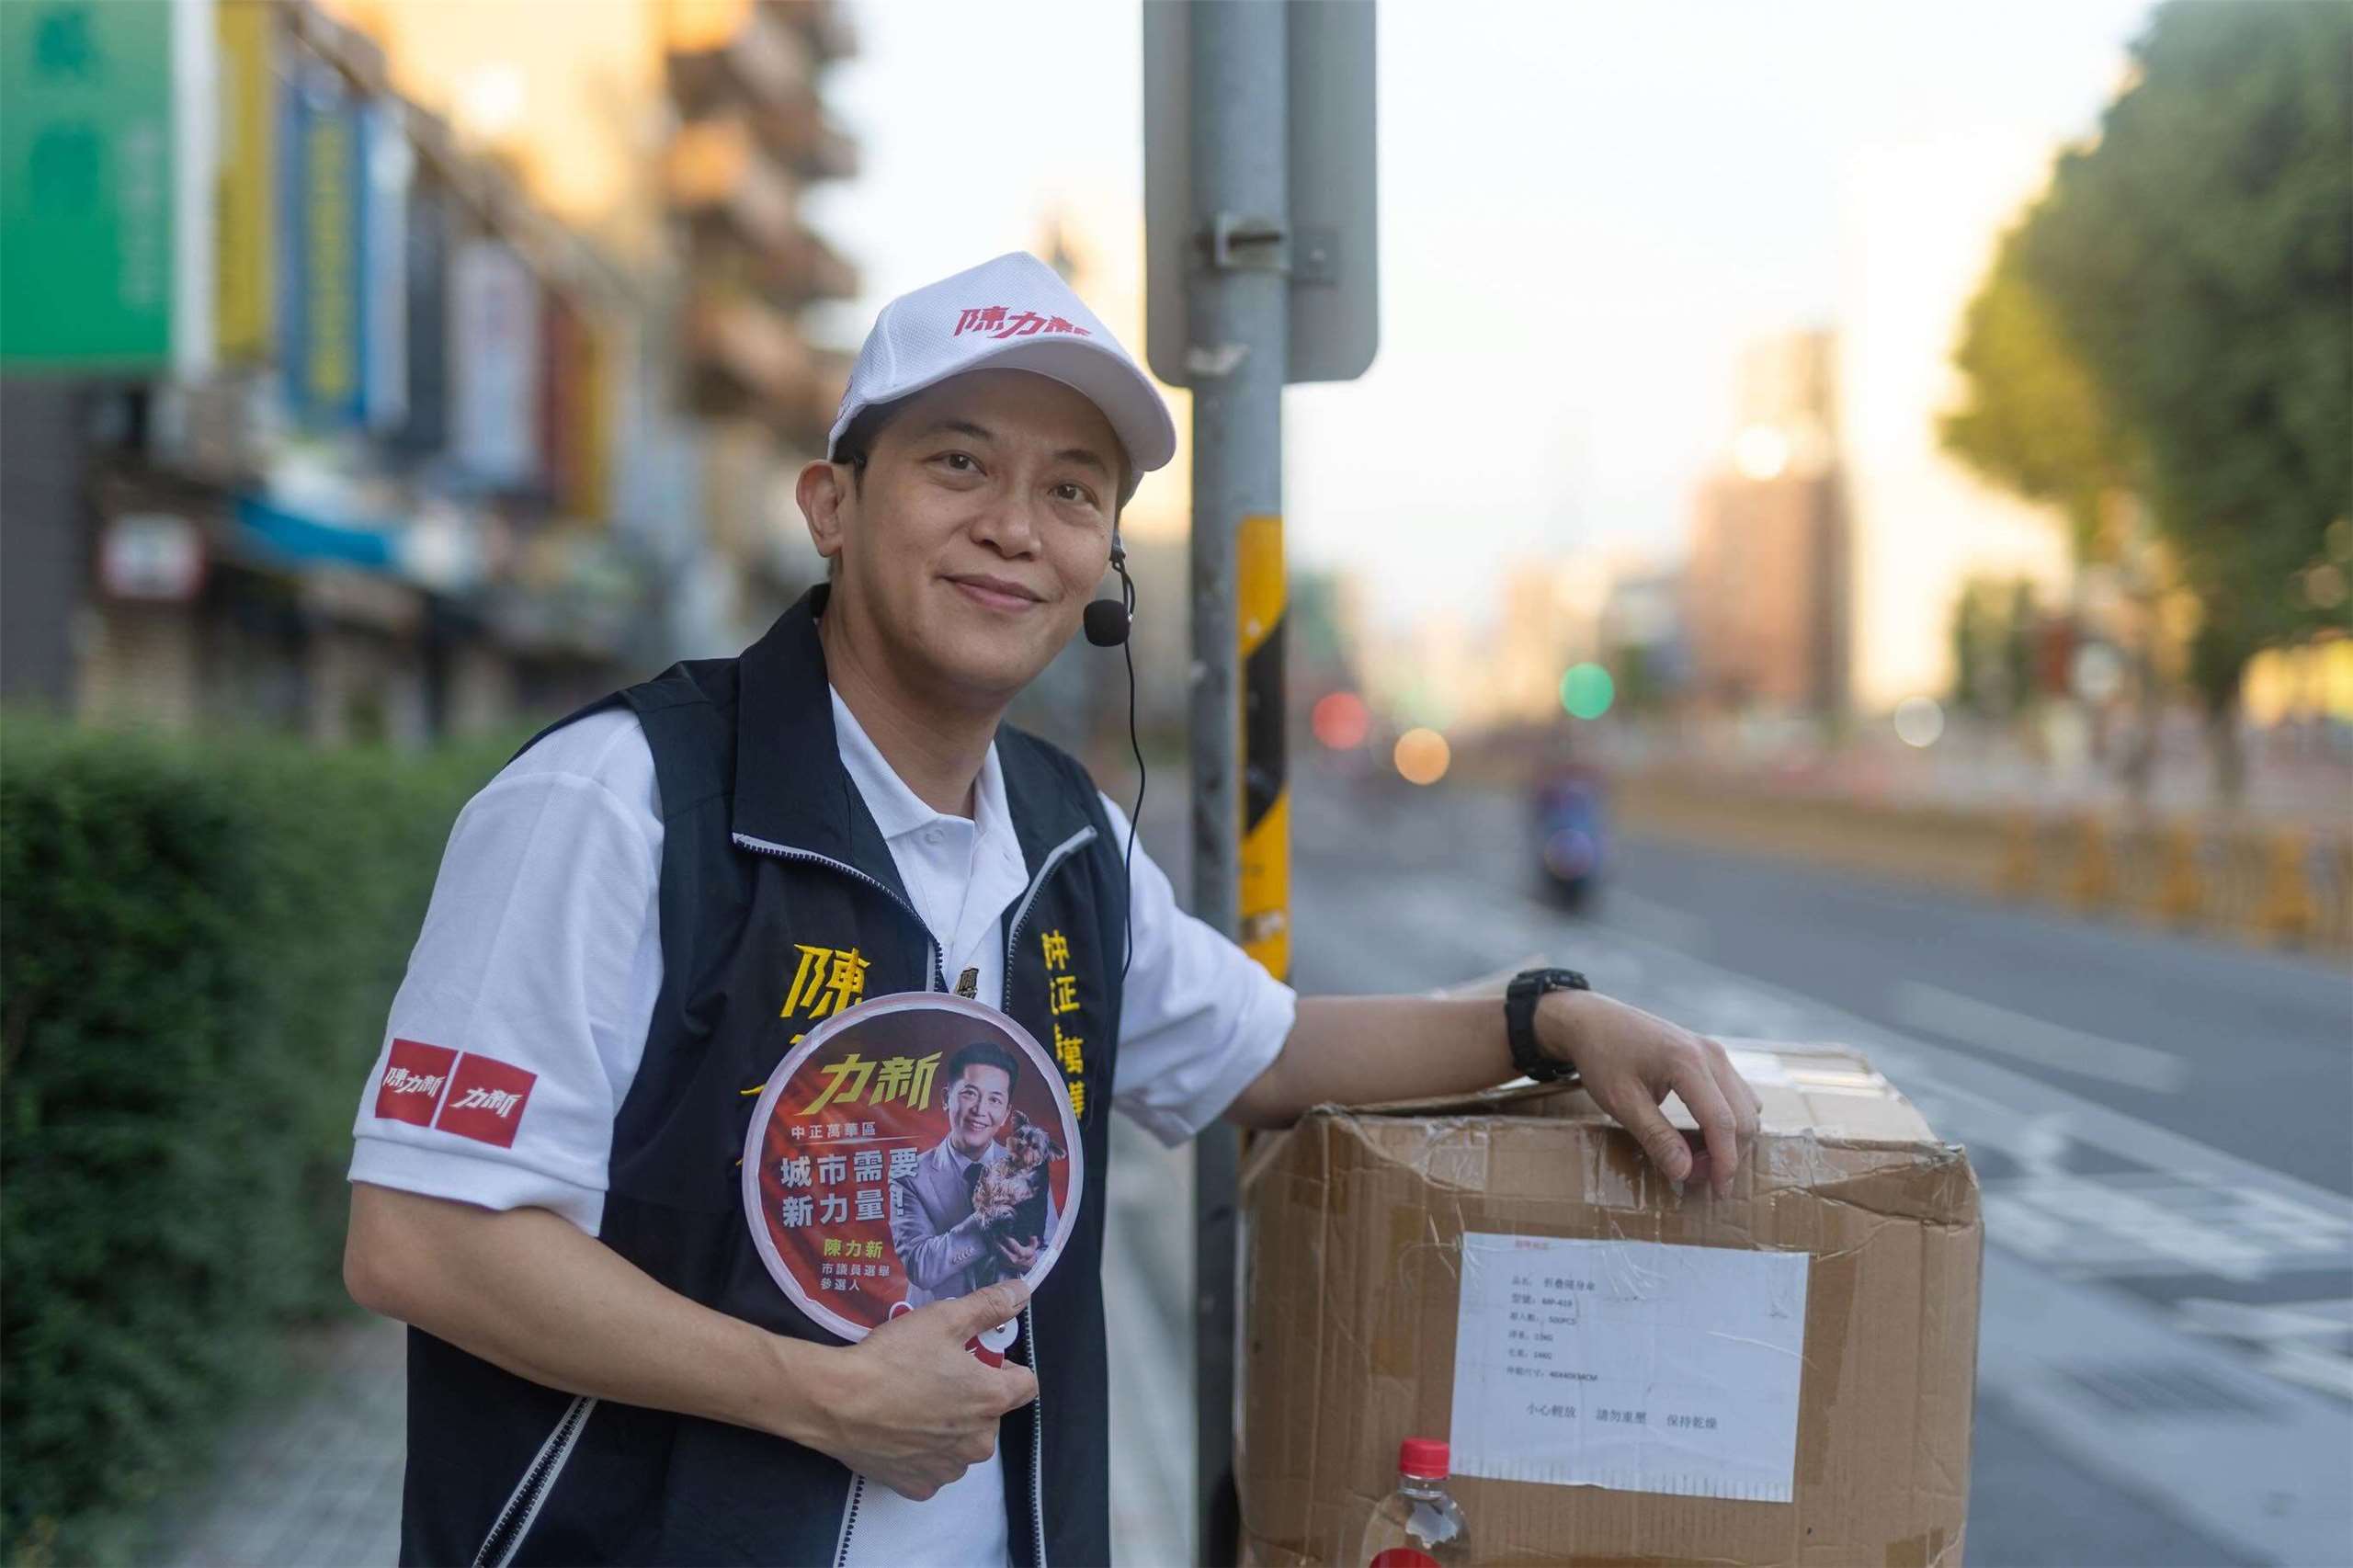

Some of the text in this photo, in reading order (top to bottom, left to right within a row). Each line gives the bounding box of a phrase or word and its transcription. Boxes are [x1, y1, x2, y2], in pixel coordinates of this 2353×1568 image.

[382, 1066, 448, 1098] 陳力新
[793, 1051, 943, 1116] 力新
[449, 1087, 523, 1119] 力新
[791, 1121, 876, 1140] 中正萬華區
[780, 1147, 919, 1188] 城市需要
[824, 1238, 883, 1259] 陳力新
[822, 1263, 890, 1277] 市議員選舉
[821, 1278, 860, 1291] 參選人
[1527, 1402, 1718, 1429] 小心輕放 請勿重壓 保持乾燥
